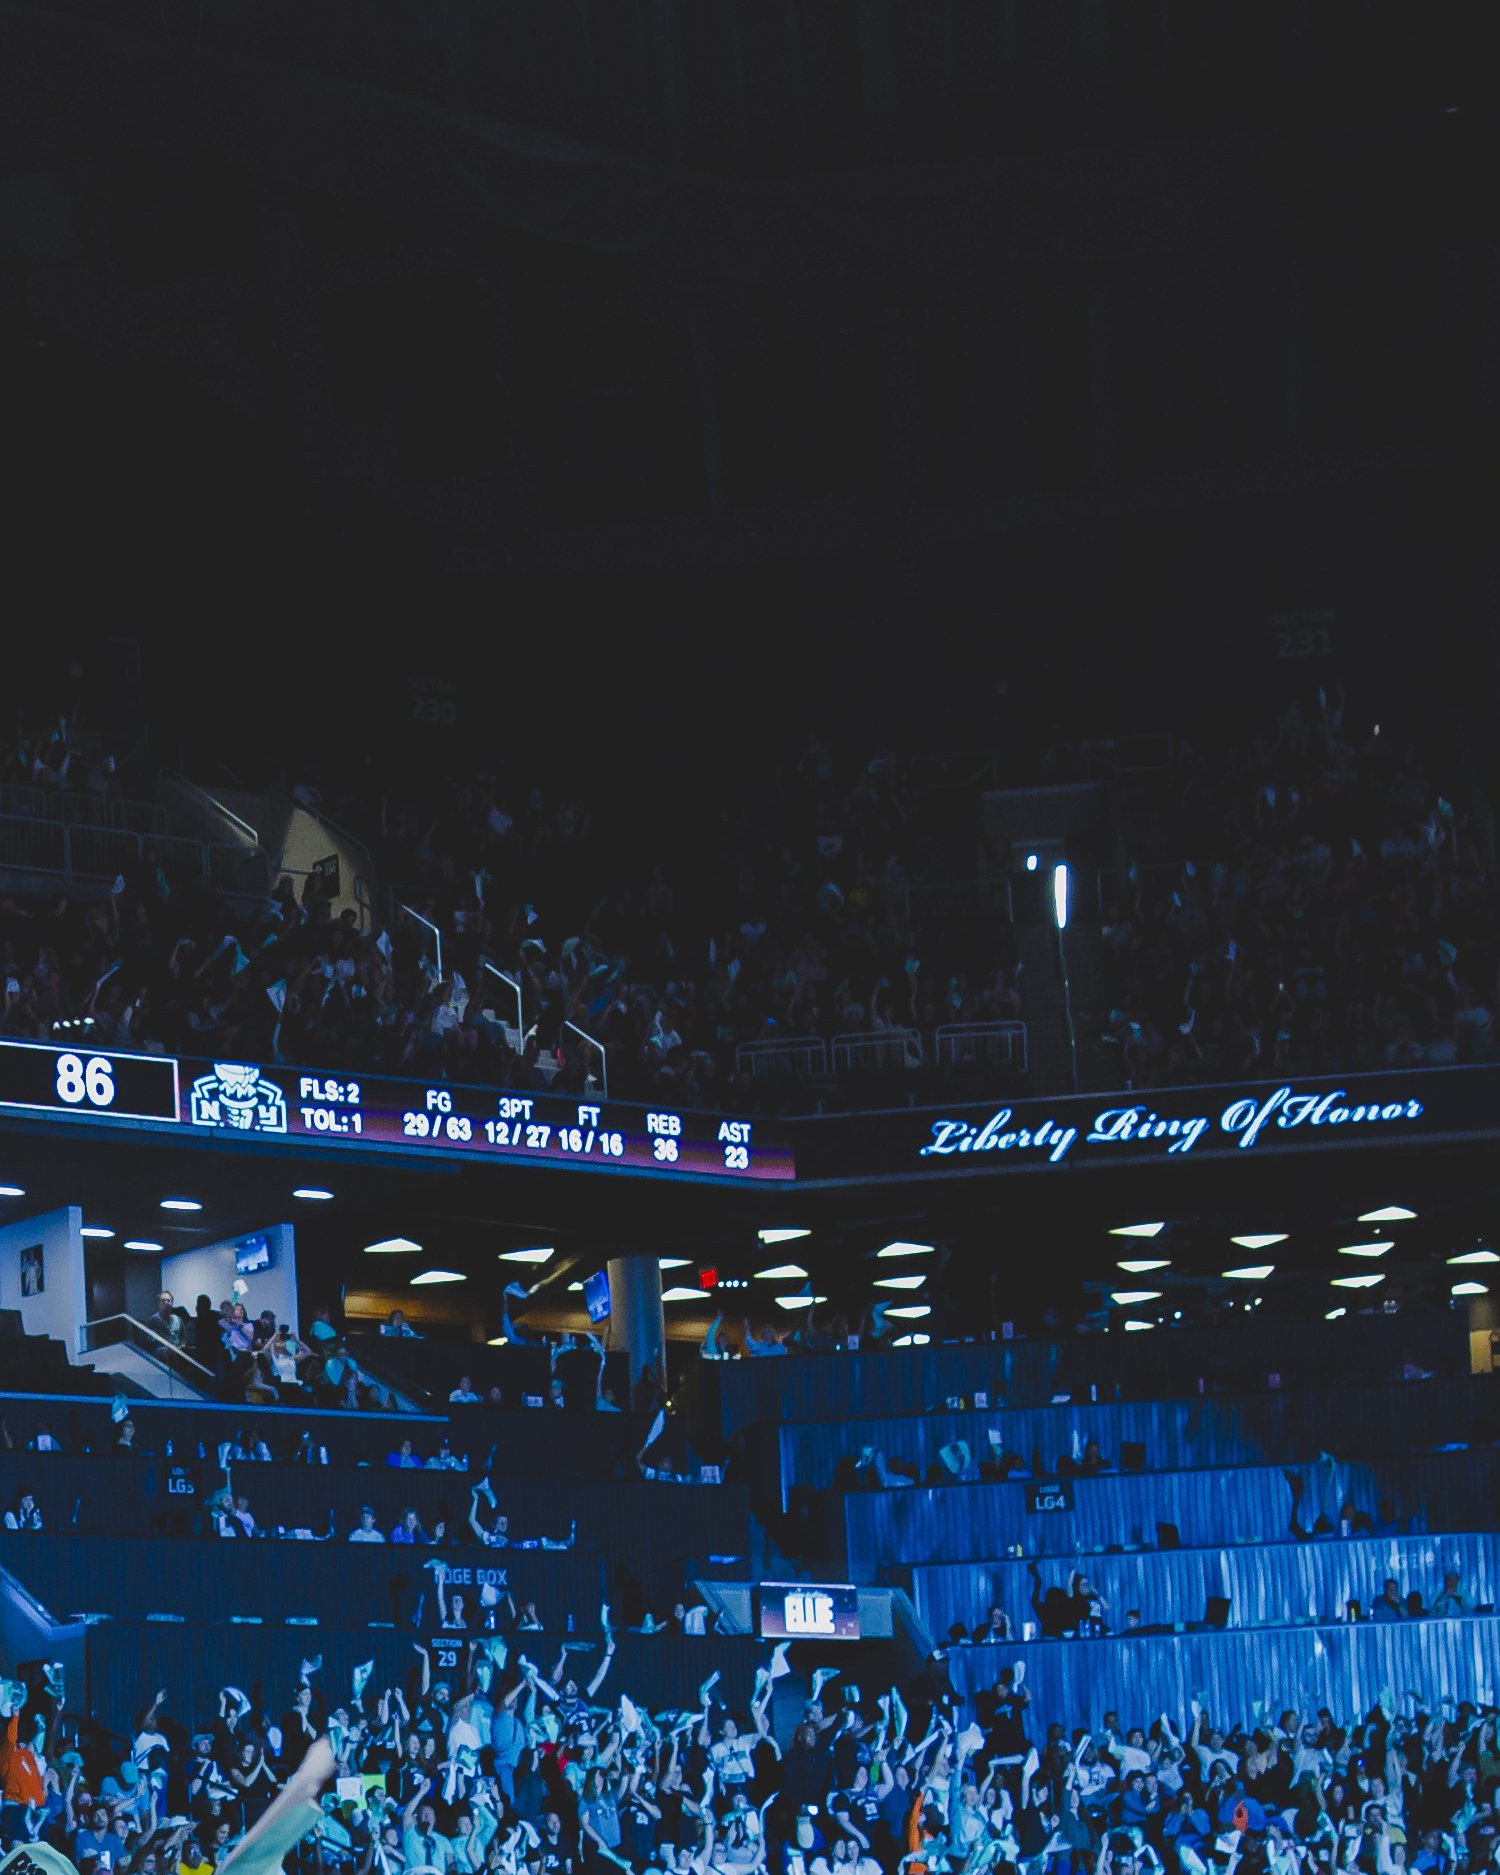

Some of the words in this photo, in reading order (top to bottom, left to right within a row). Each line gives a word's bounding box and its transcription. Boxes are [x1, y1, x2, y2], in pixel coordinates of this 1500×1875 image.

[55, 1053, 115, 1107] 86
[425, 1090, 453, 1113] FG
[498, 1097, 535, 1121] 3PT
[577, 1105, 601, 1129] FT
[646, 1112, 681, 1137] REB
[919, 1107, 1079, 1163] Liberty
[1086, 1105, 1208, 1153] Ring
[1277, 1089, 1424, 1129] Honor
[718, 1121, 752, 1146] AST
[653, 1136, 679, 1162] 36
[724, 1144, 750, 1170] 23
[1034, 1494, 1066, 1511] LG4
[438, 1651, 458, 1667] 29
